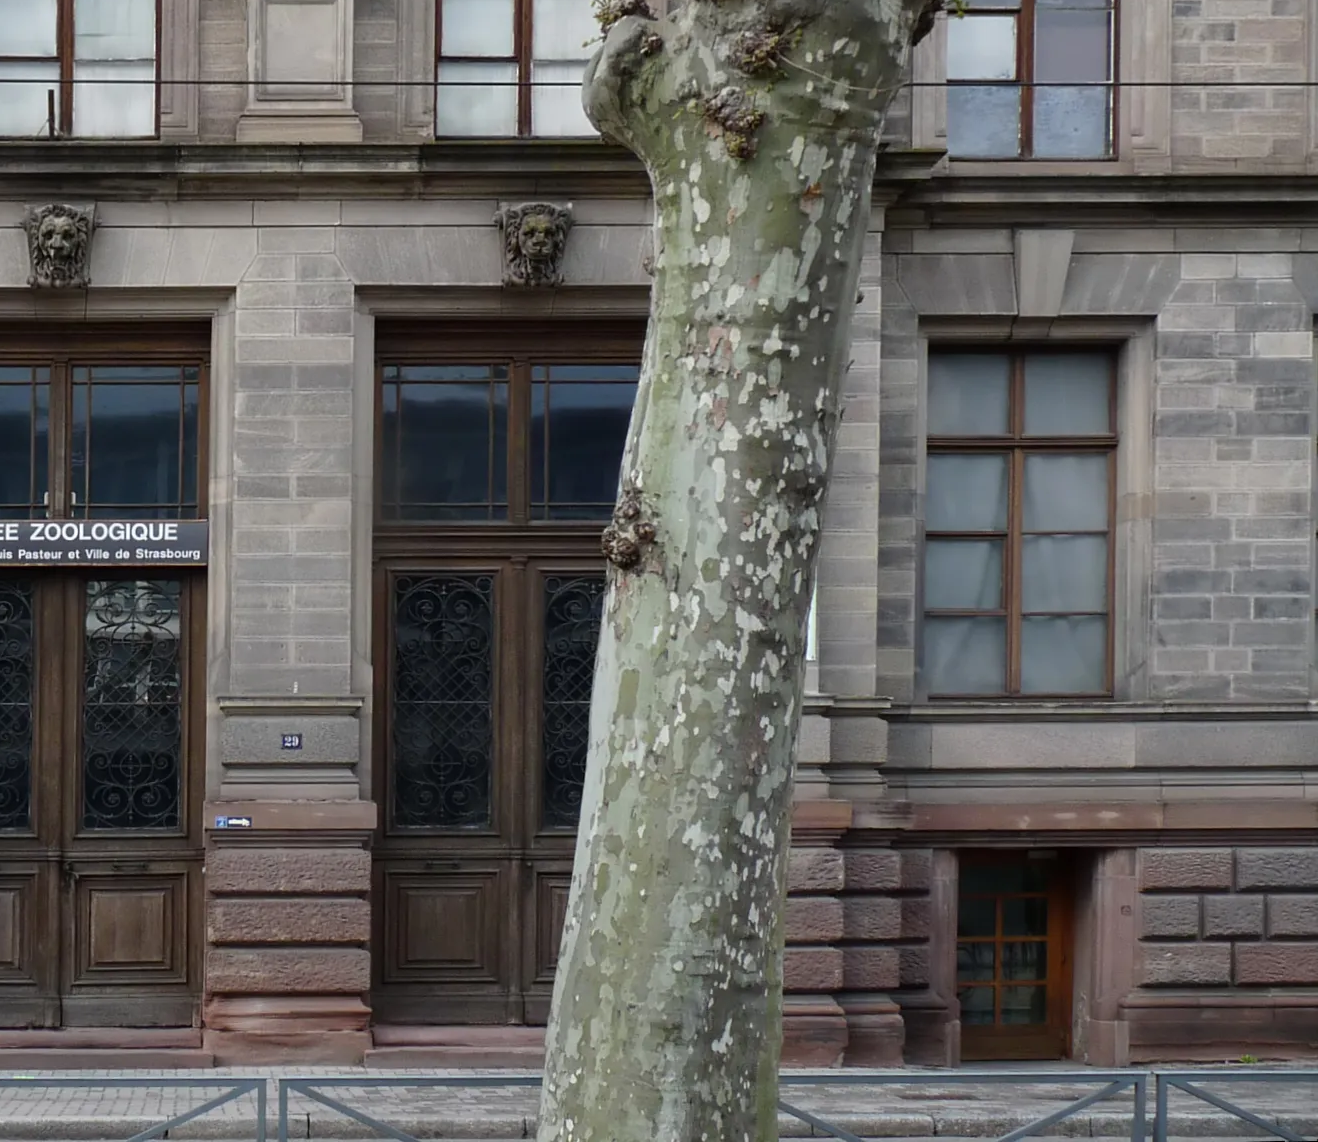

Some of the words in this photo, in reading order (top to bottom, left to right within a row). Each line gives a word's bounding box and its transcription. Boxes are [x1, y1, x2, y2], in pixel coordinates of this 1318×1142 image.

[29, 522, 179, 542] ZOOLOGIQUE
[18, 549, 63, 560] Pasteur
[68, 549, 80, 559] et
[85, 548, 110, 560] Ville
[115, 548, 130, 559] de
[135, 548, 201, 561] Strasbourg
[284, 735, 299, 747] 29
